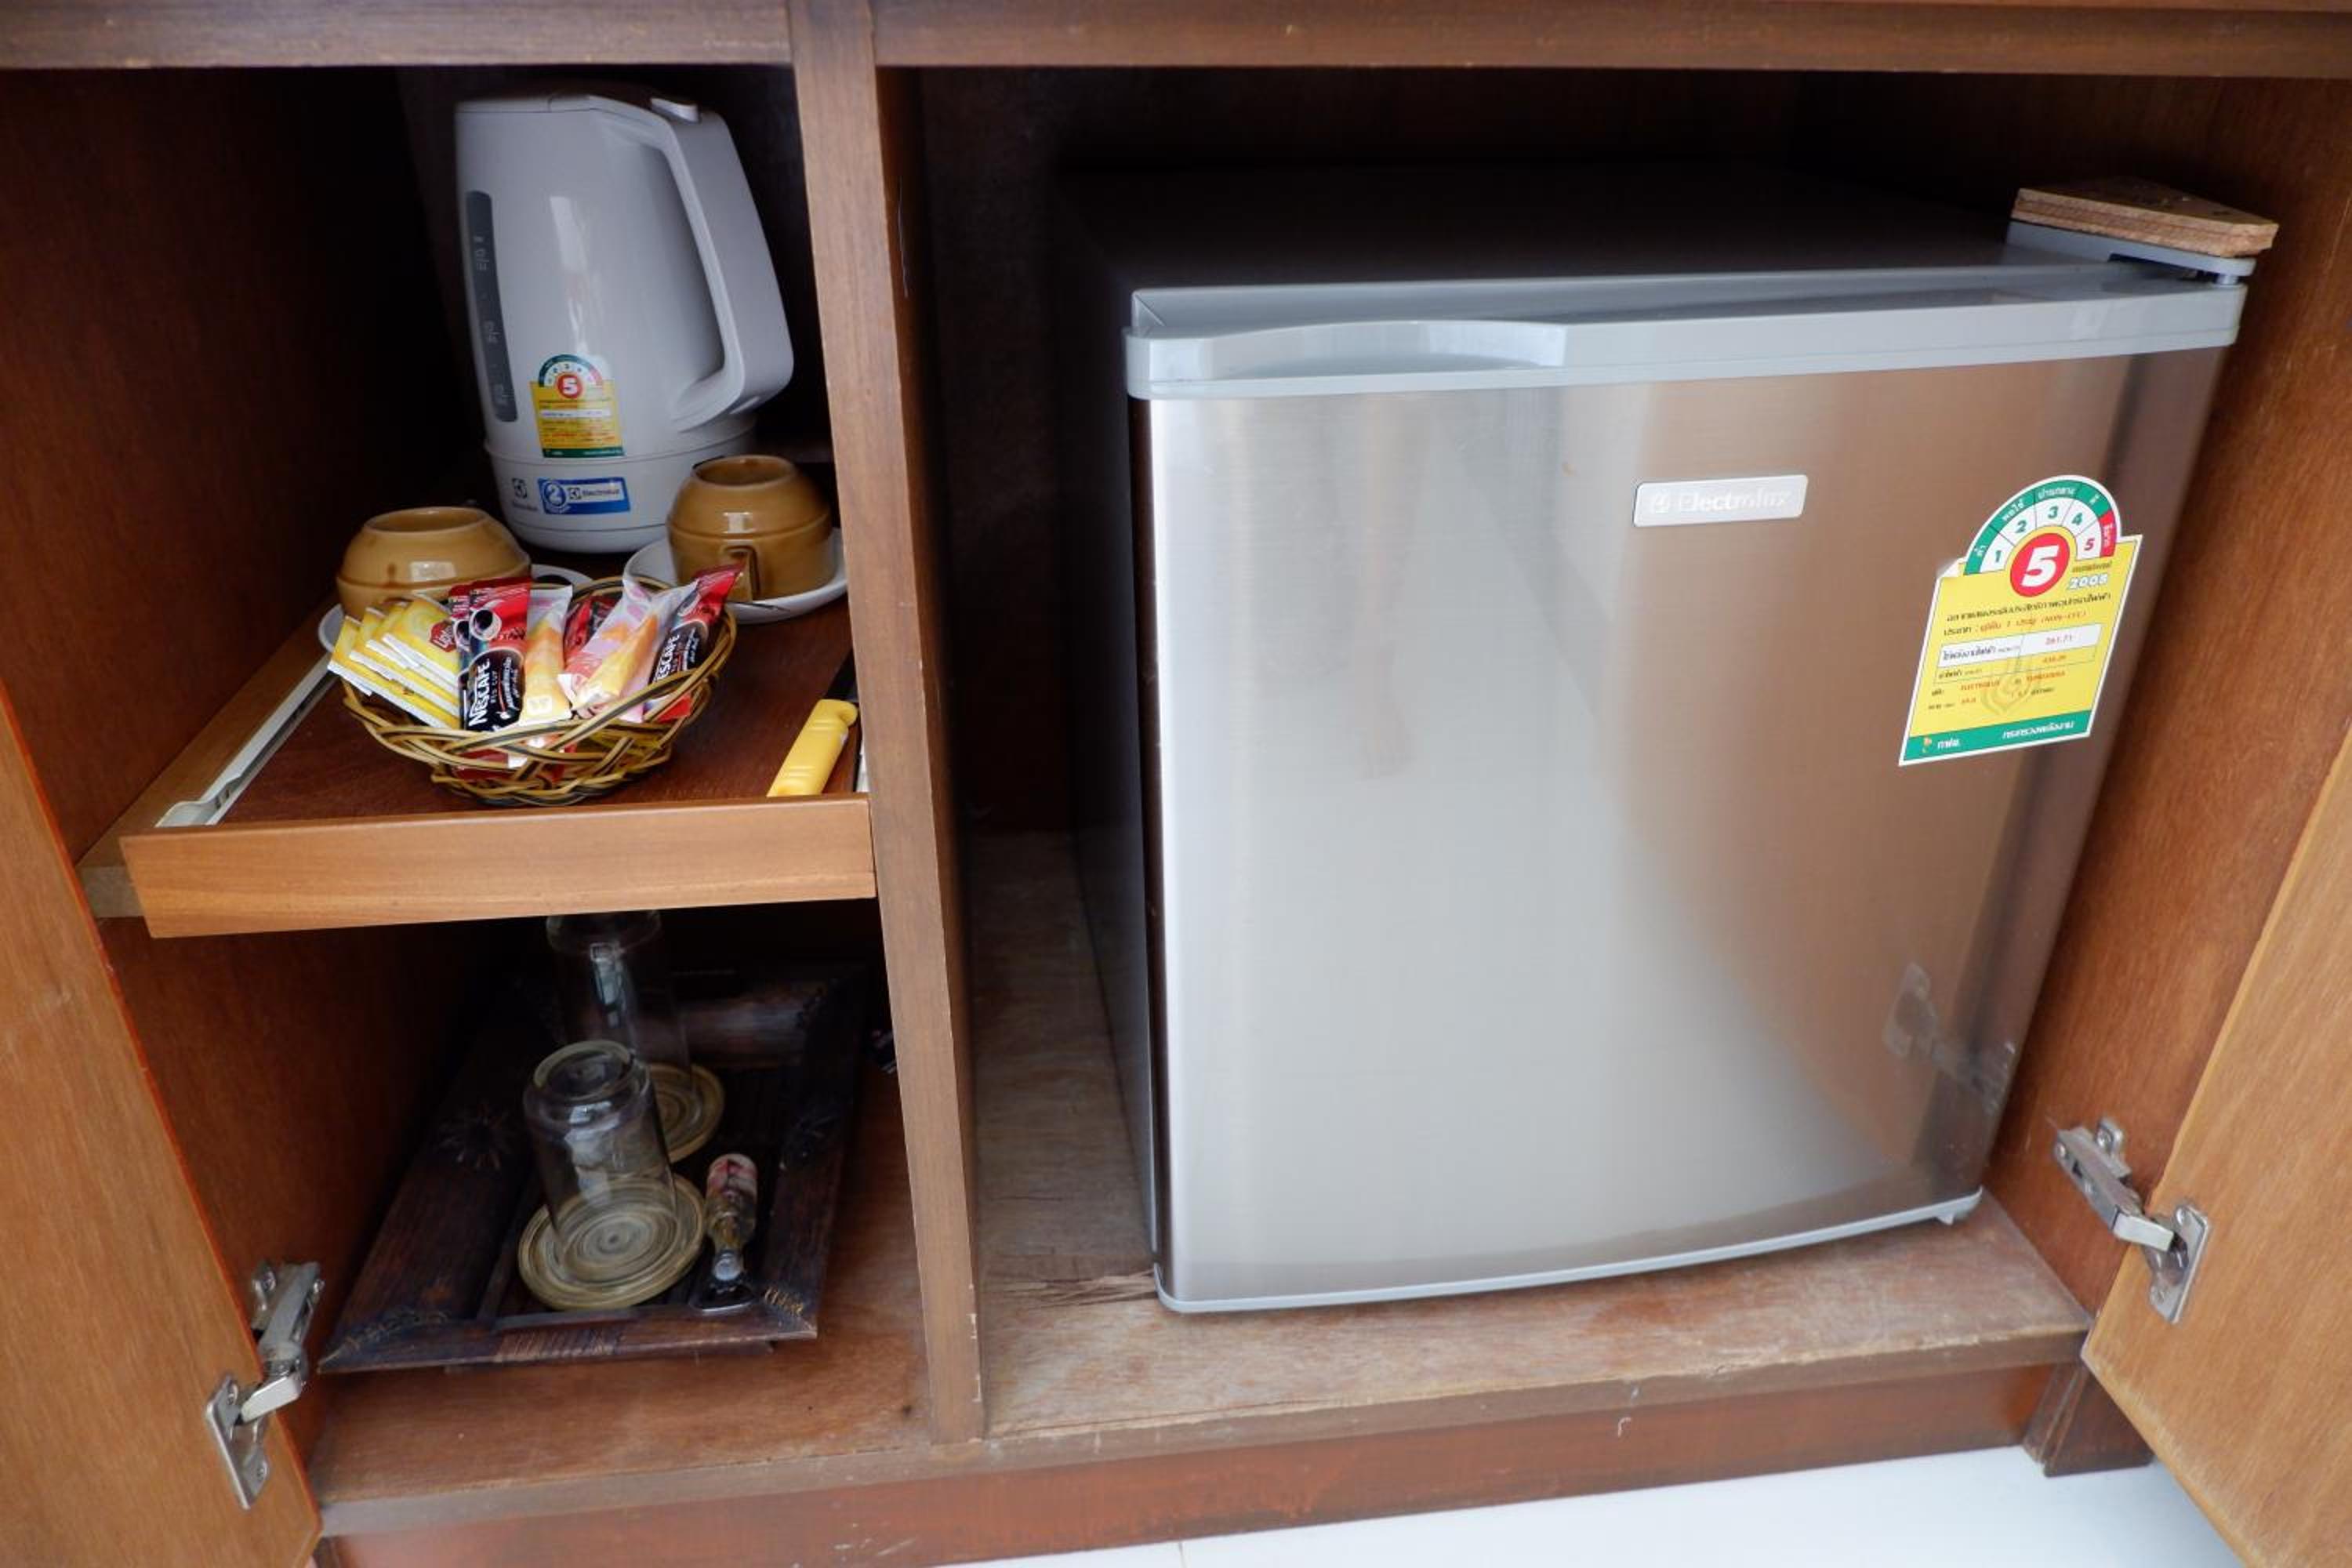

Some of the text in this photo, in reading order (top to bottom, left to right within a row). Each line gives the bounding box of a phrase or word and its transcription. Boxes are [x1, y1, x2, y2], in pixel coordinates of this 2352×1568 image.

[562, 377, 579, 395] 5
[1994, 506, 2096, 563] 1 2 3 4 5
[2020, 543, 2060, 587] 5
